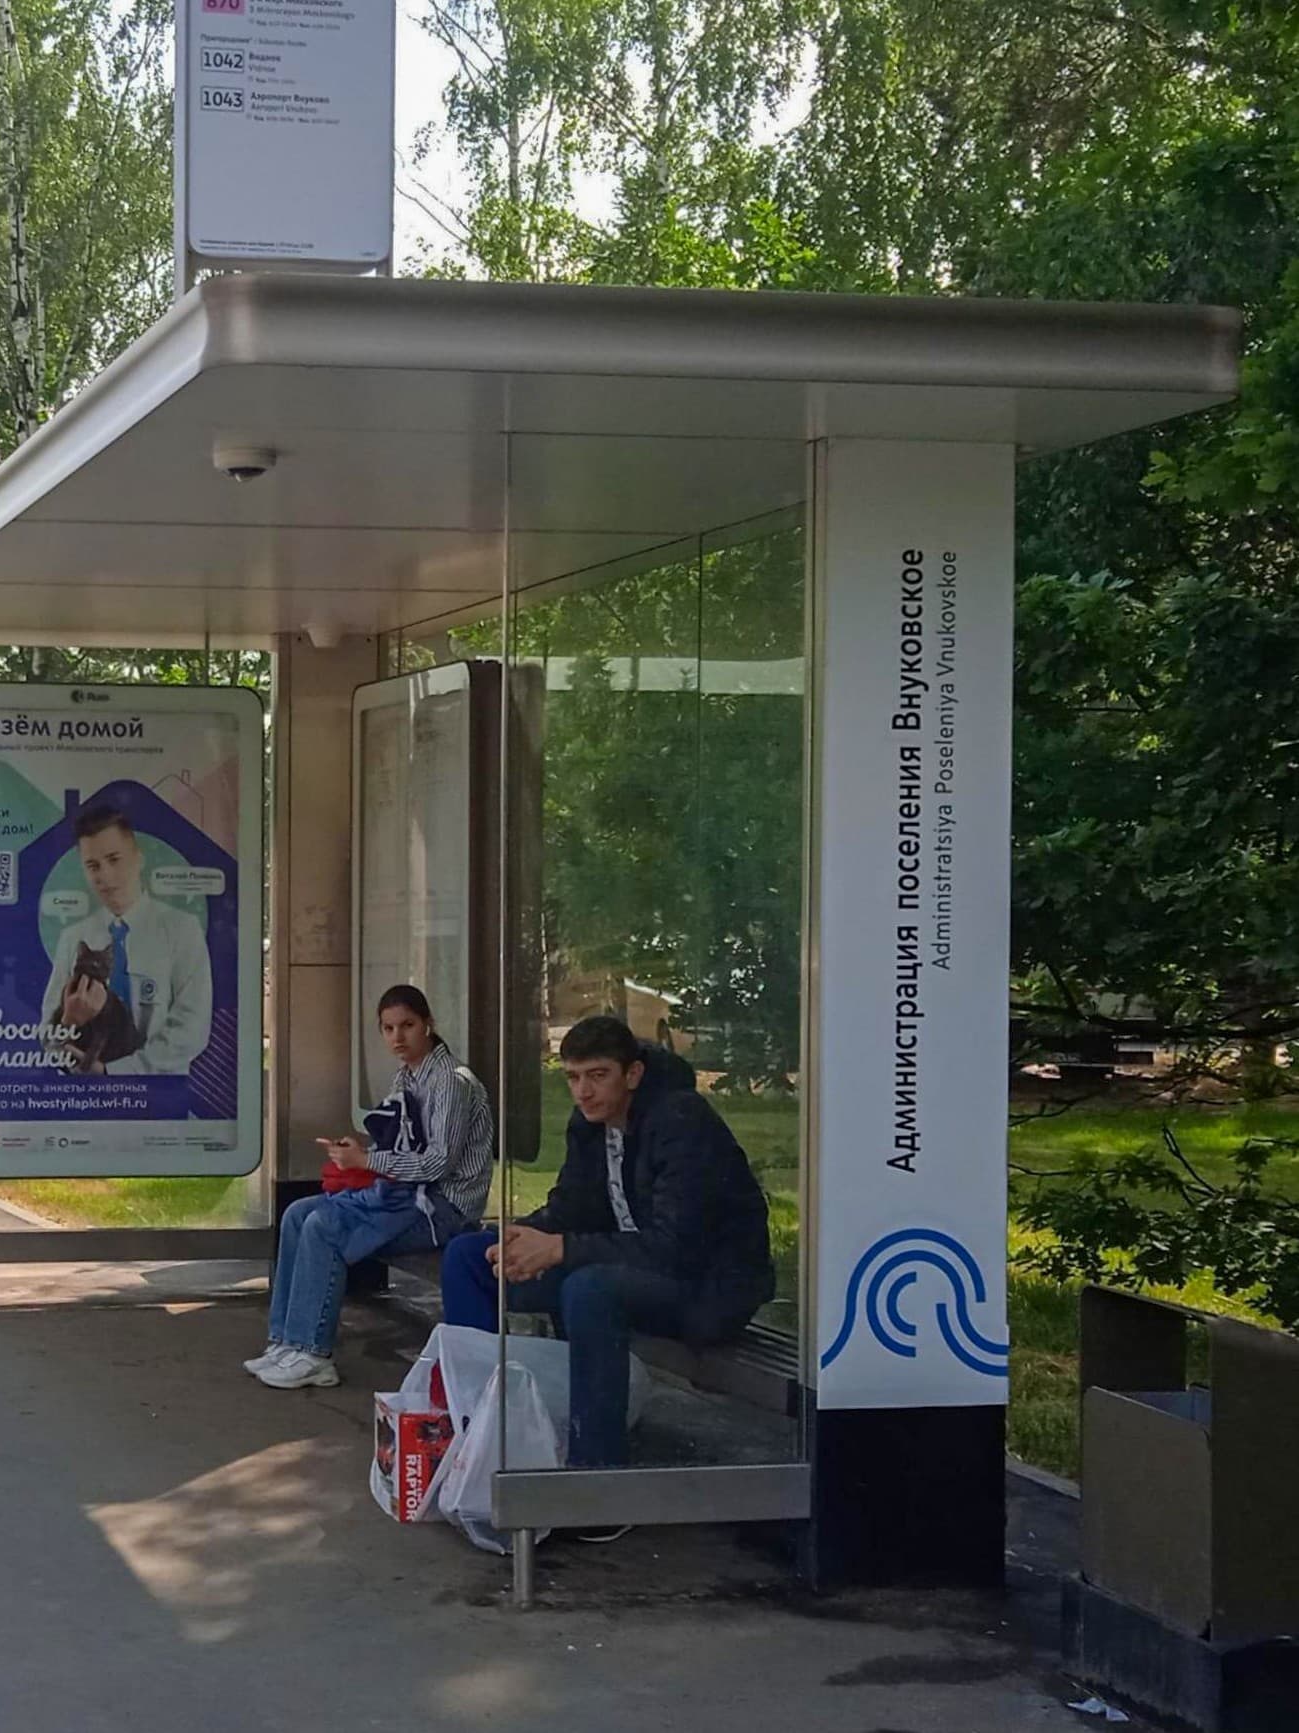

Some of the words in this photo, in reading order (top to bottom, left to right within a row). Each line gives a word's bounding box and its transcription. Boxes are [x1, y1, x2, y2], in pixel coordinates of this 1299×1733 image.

[203, 51, 243, 69] 1042
[203, 91, 243, 108] 1043
[891, 549, 929, 731] Внуковское
[936, 552, 957, 677] Vnukovskoe
[58, 717, 143, 739] домой
[934, 683, 959, 794] Poseleniya
[2, 824, 34, 835] дом!
[898, 747, 922, 910] поселения
[932, 805, 957, 971] Administratsiya
[886, 925, 924, 1174] Администрация
[11, 1100, 25, 1110] на
[43, 1083, 85, 1093] анкеты
[87, 1083, 148, 1093] животных
